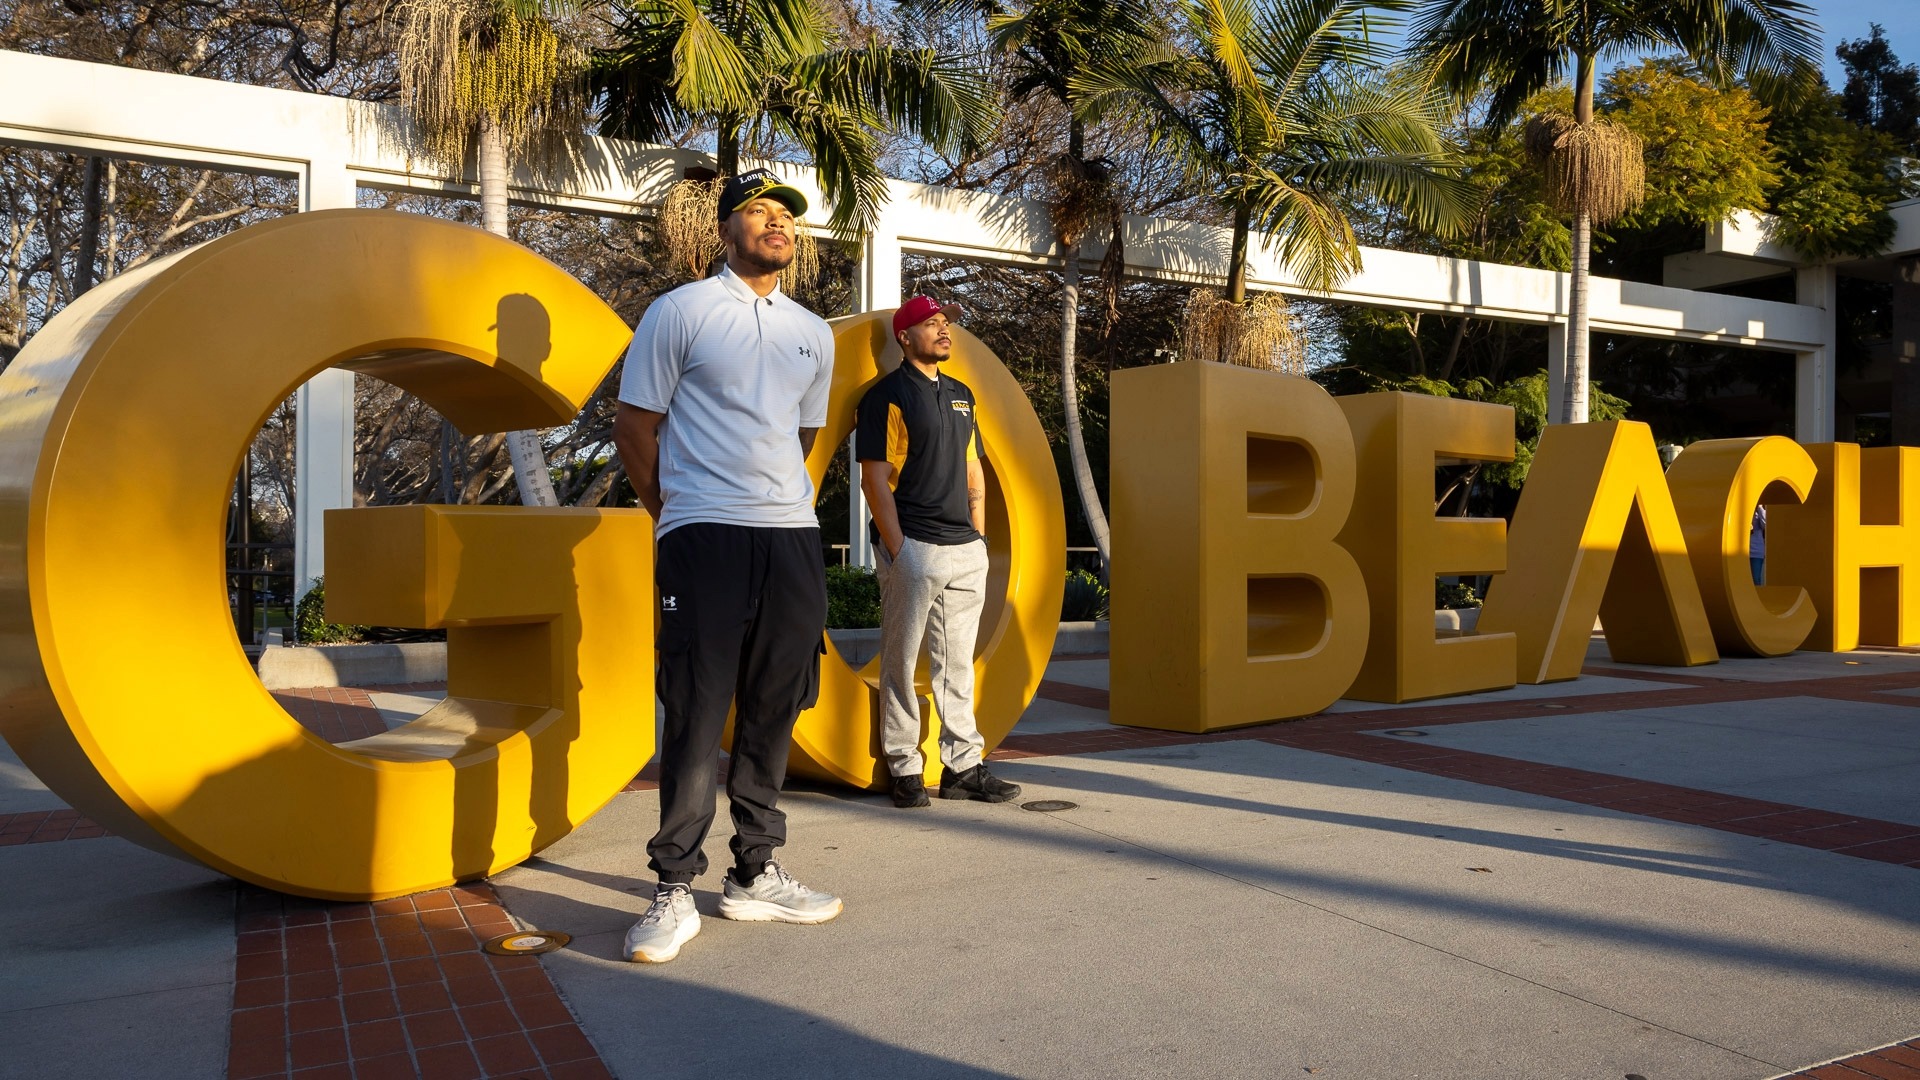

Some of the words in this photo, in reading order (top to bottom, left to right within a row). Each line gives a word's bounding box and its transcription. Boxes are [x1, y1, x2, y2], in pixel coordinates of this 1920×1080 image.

[738, 172, 763, 184] Long
[0, 207, 1066, 902] GO
[1110, 358, 1920, 733] BEACH
